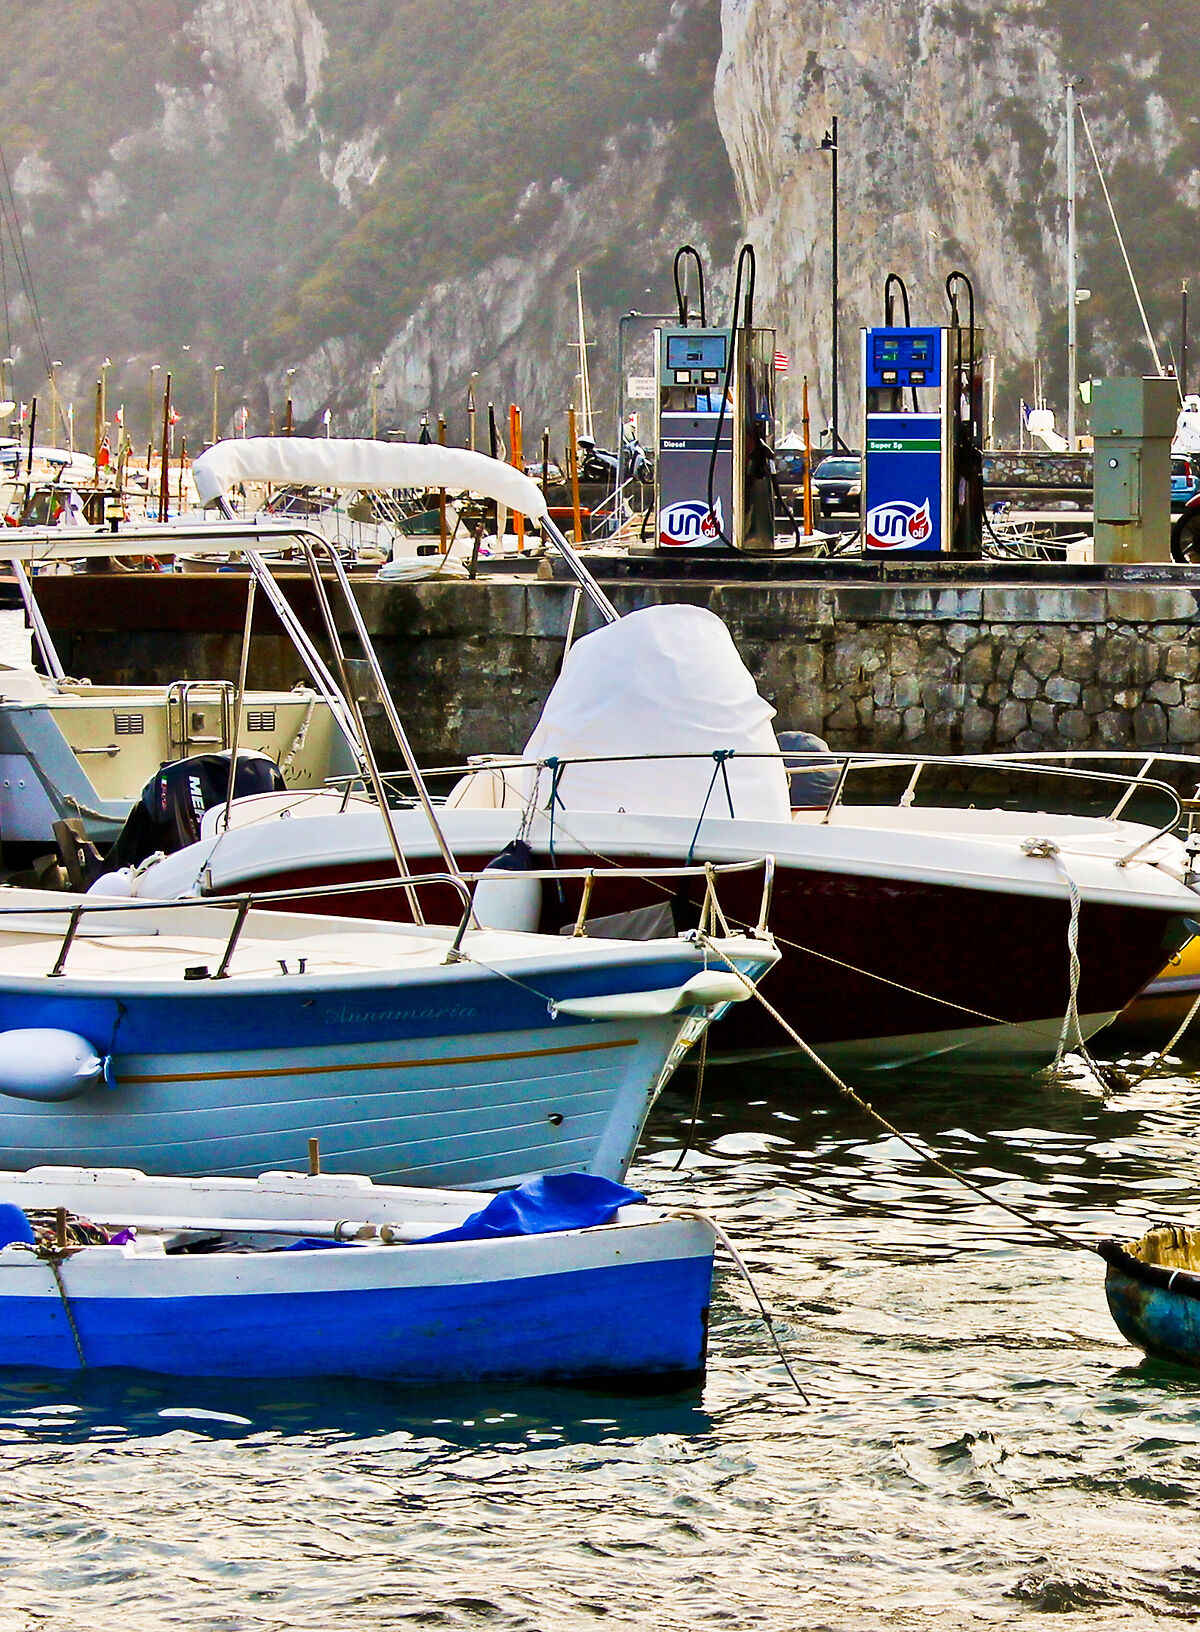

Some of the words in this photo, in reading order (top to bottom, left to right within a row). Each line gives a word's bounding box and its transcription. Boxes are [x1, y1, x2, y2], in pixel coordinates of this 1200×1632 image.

[663, 440, 686, 448] Diesel
[870, 442, 891, 450] Super
[893, 442, 903, 450] Sp
[912, 527, 925, 538] oil
[325, 1001, 478, 1025] Annamaria
